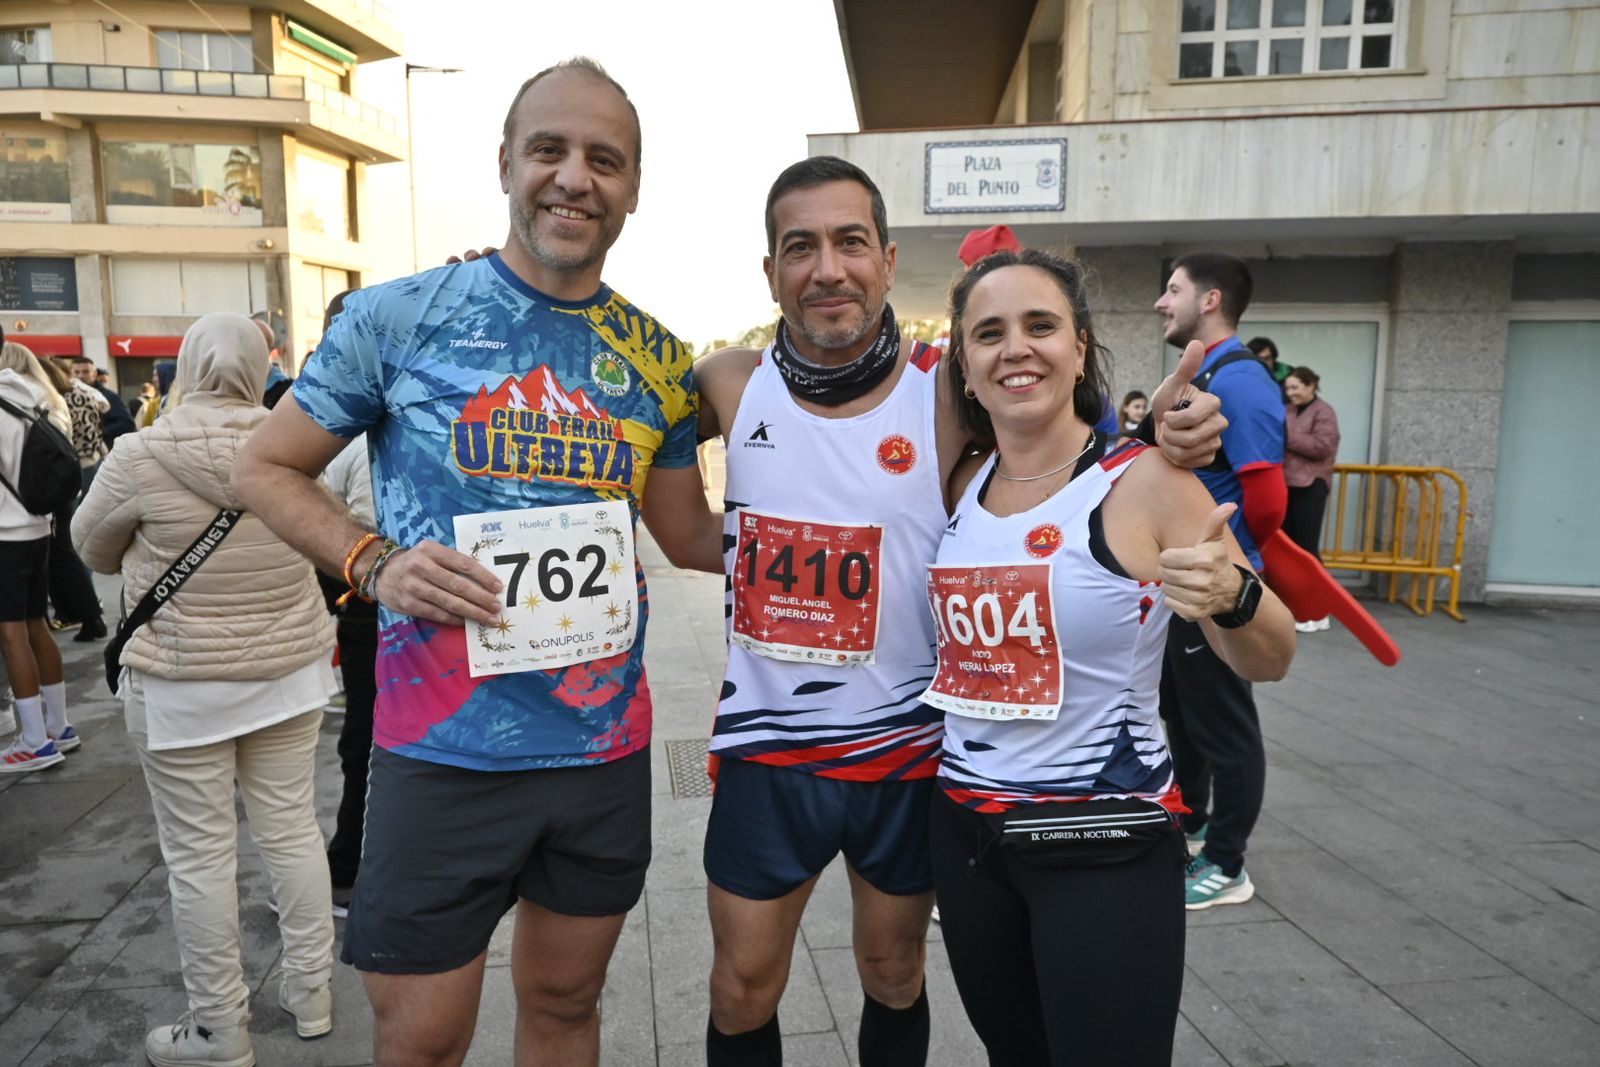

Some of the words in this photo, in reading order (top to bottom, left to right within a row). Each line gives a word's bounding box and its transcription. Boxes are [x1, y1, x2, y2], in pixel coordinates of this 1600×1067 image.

[965, 155, 1001, 172] PLAZA
[947, 182, 968, 195] DEL
[979, 179, 1020, 196] PUNTO
[448, 339, 508, 350] TEAMERGY
[490, 408, 550, 434] CLUB
[556, 415, 615, 440] TRAIL
[453, 421, 635, 486] ULTREYA
[518, 519, 551, 532] Huelva
[767, 524, 794, 536] Huelva
[493, 544, 609, 608] 762
[743, 538, 871, 601] 1410
[939, 577, 966, 585] Huelva
[769, 594, 800, 606] MIGUEL
[802, 599, 832, 609] ANGEL
[763, 605, 808, 619] ROMERO
[810, 611, 835, 622] DIAZ
[540, 631, 594, 649] ONUPOLIS
[1031, 833, 1040, 841] IX
[1042, 831, 1081, 840] CARRERA
[1083, 829, 1130, 839] NOCTURNA
